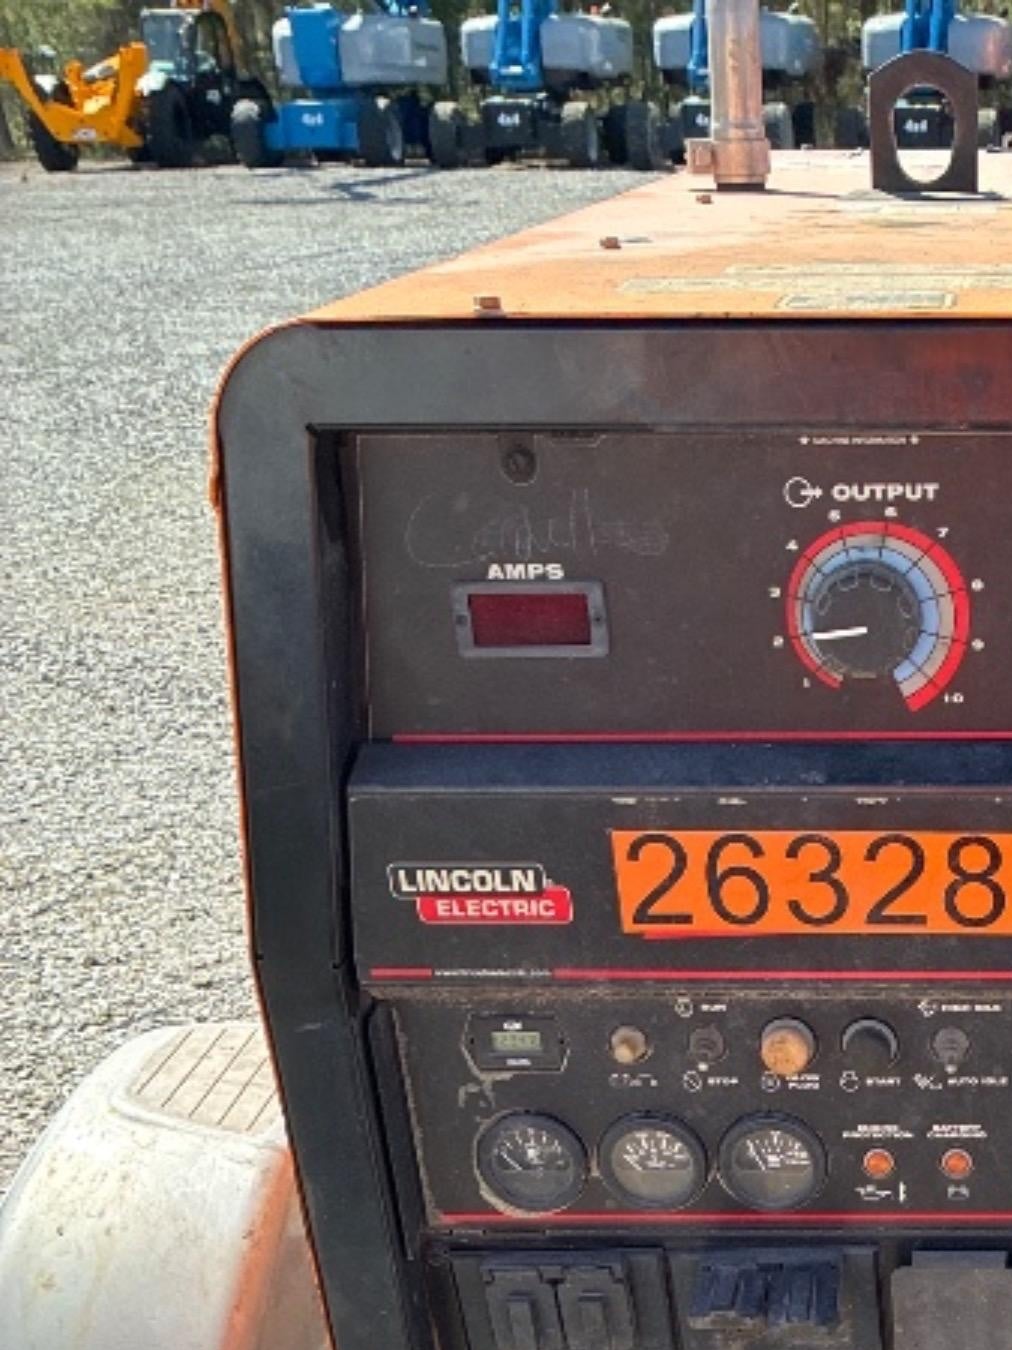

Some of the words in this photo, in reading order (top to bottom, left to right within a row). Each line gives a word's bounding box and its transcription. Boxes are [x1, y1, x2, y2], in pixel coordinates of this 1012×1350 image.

[831, 481, 940, 501] OUTPUT
[937, 526, 950, 539] 7
[785, 539, 799, 552] 4
[487, 562, 564, 581] AMPS
[768, 586, 782, 599] 3
[397, 868, 538, 892] LINCOLN
[435, 898, 557, 917] ELECTRIC
